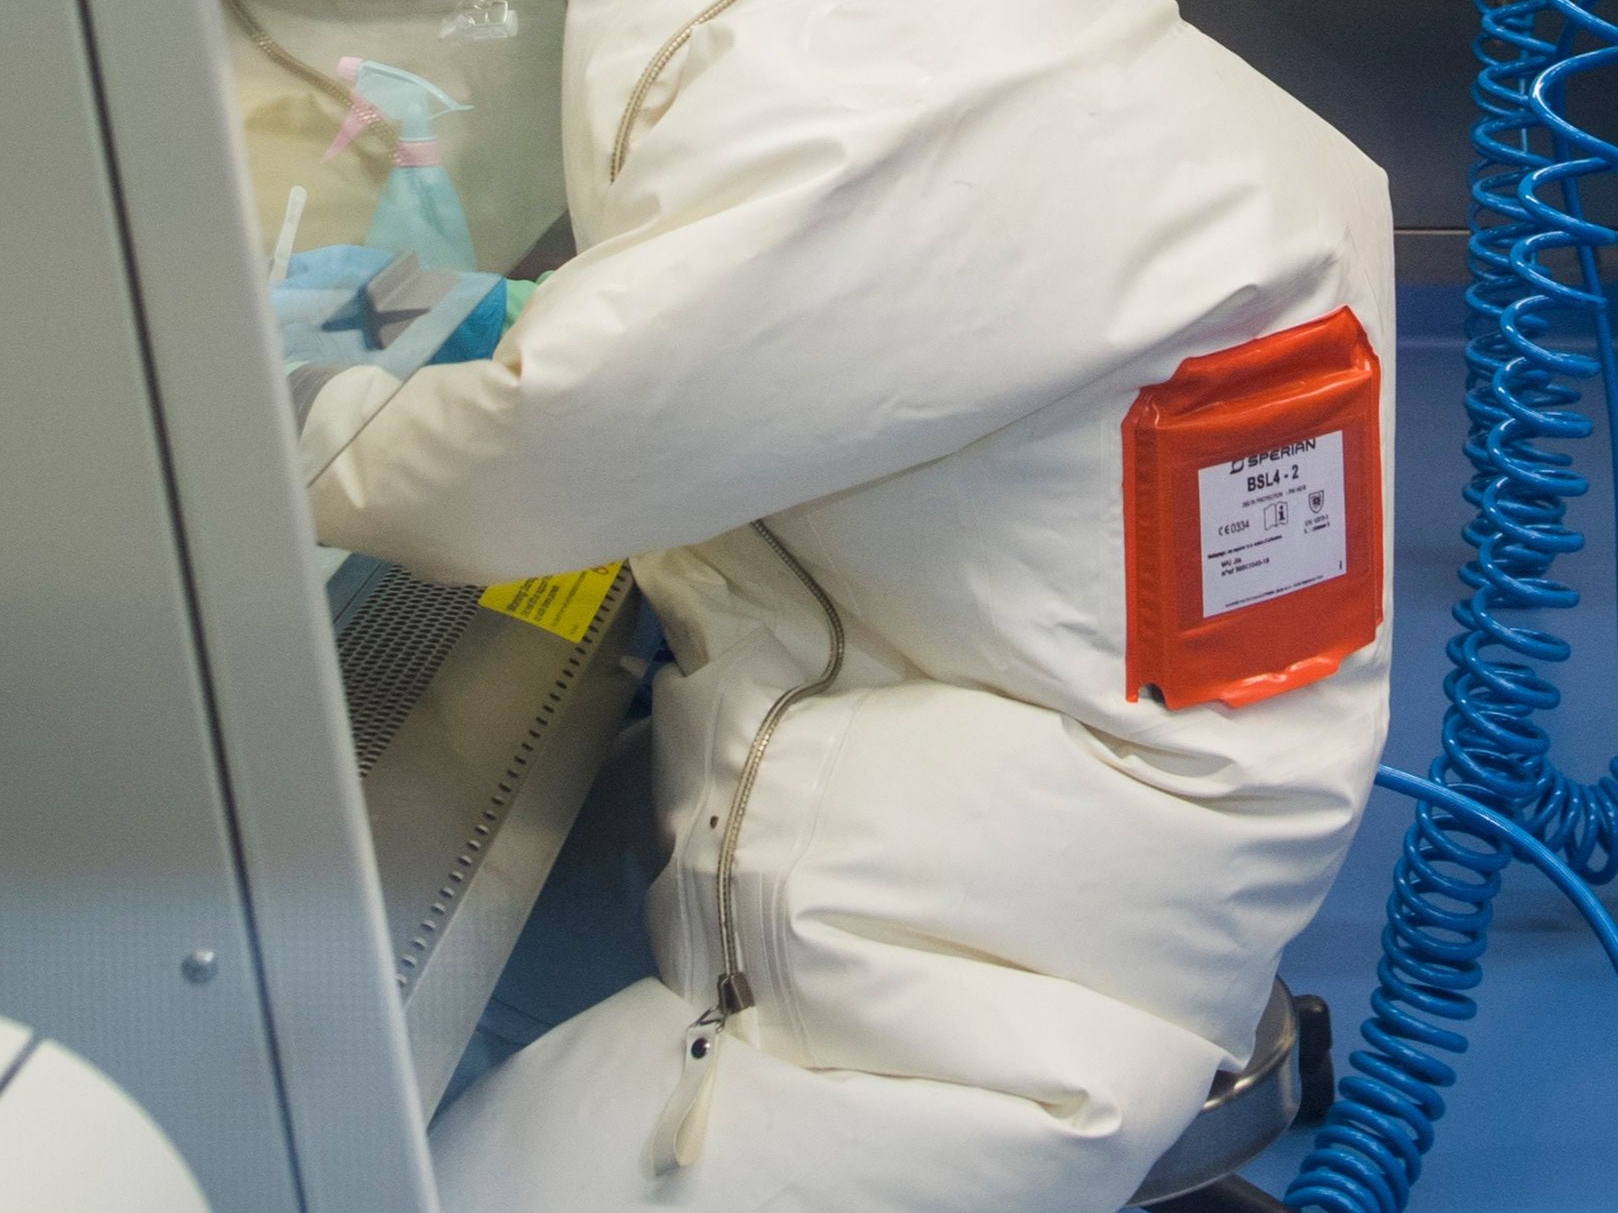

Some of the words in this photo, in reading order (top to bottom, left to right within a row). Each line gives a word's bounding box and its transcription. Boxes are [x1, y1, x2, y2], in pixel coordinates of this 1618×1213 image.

[1248, 438, 1316, 468] SPERIAN
[1247, 469, 1281, 492] BSL4
[1291, 464, 1299, 480] 2
